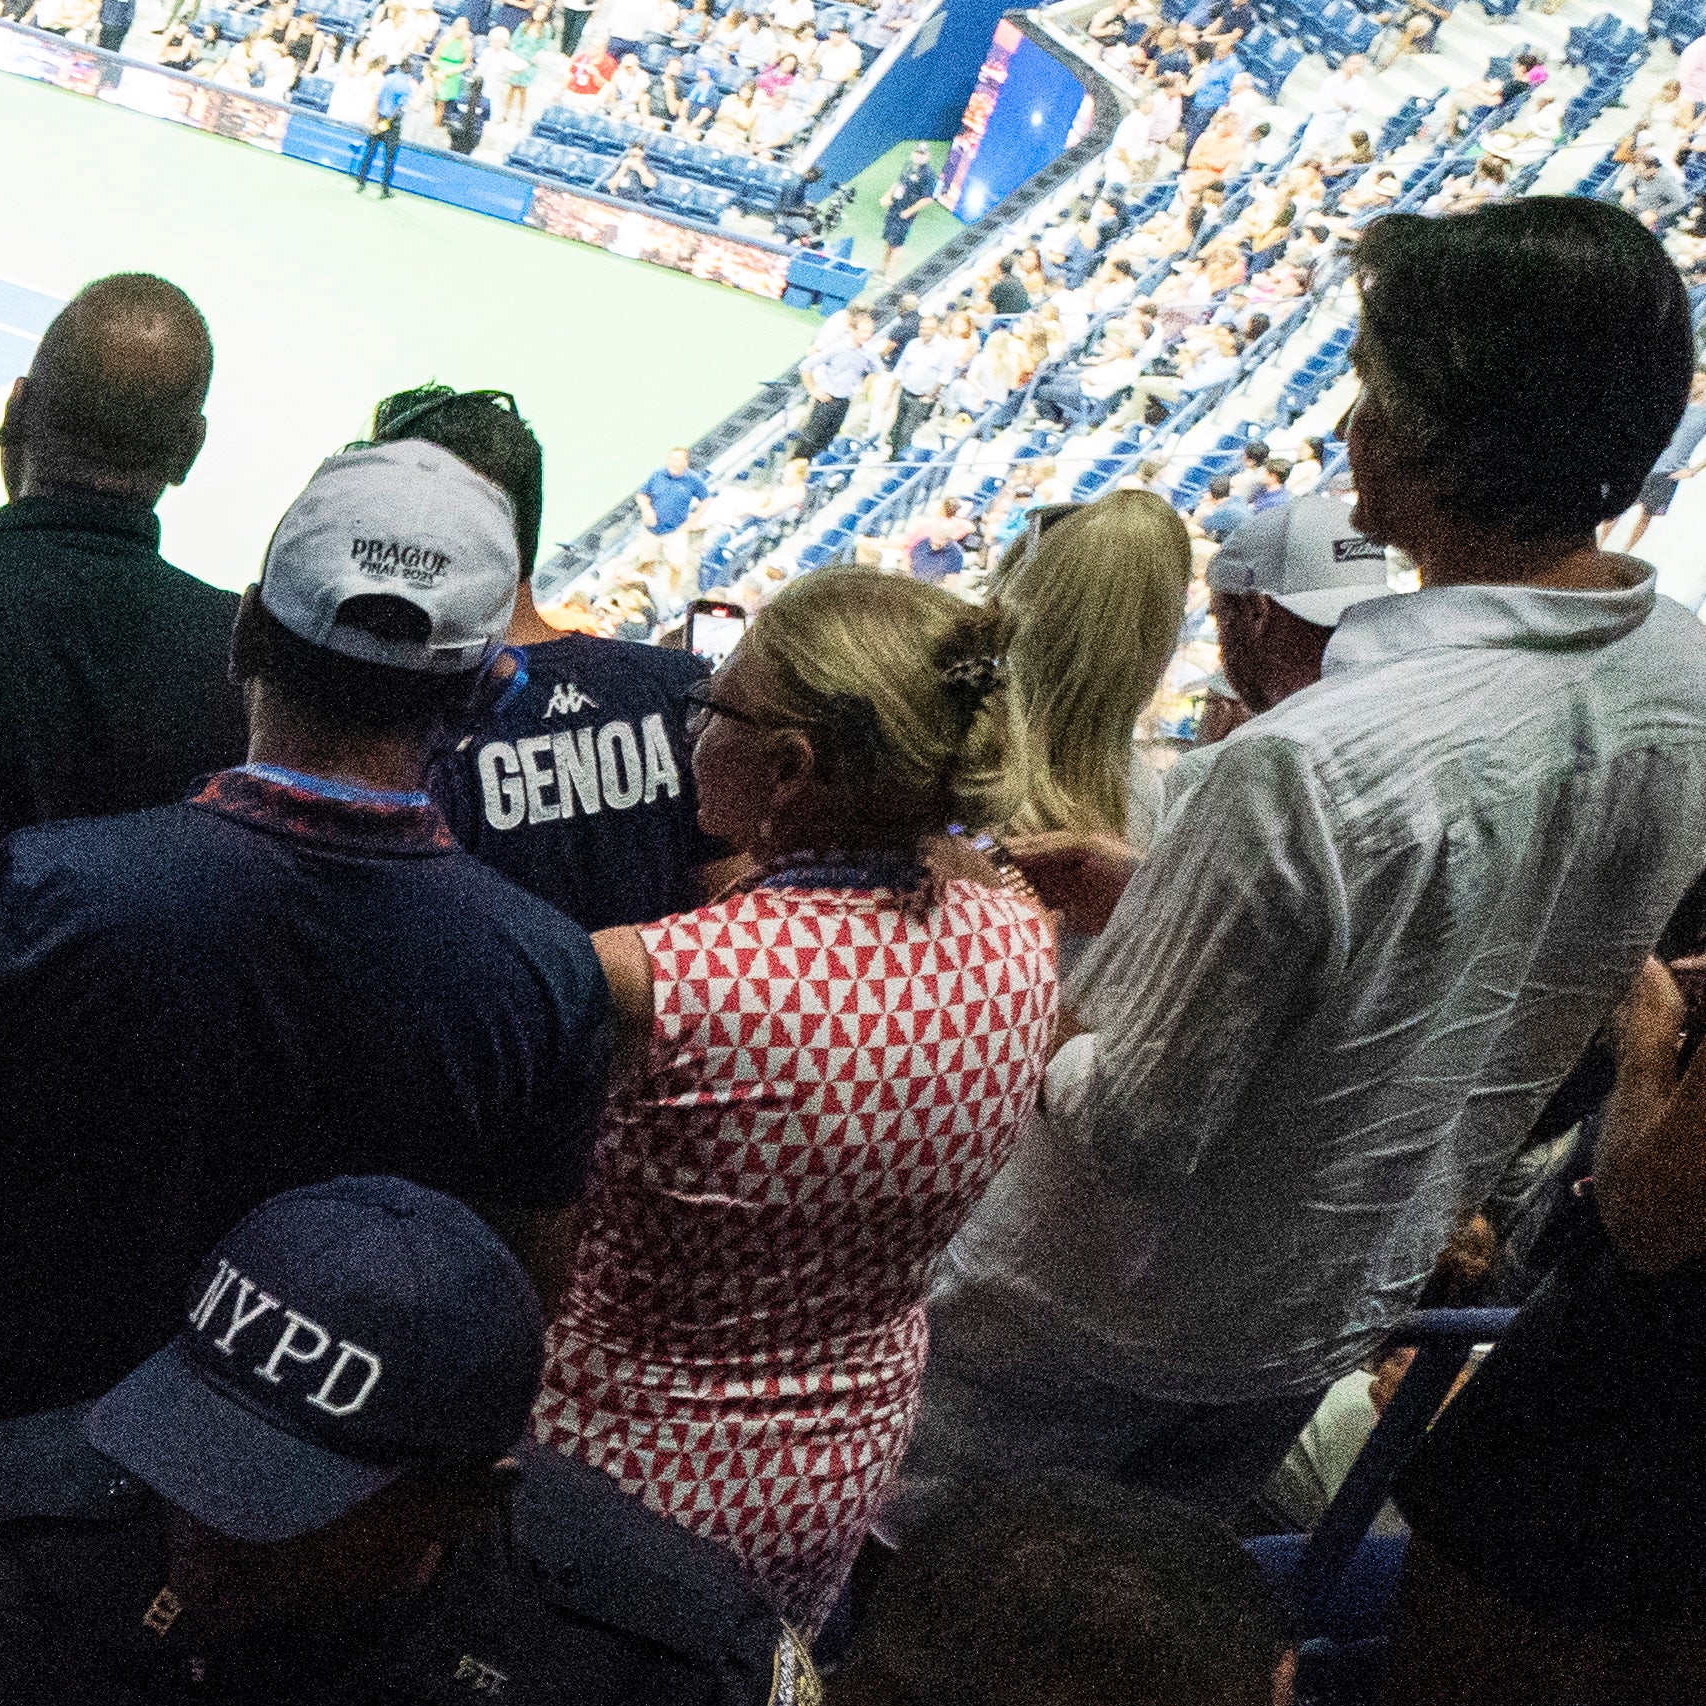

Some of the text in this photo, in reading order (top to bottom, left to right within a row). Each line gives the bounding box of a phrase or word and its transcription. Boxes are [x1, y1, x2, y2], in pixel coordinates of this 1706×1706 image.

[351, 539, 451, 576] PRAGUE
[477, 712, 681, 831] GENOA
[189, 1258, 383, 1418] NYPD
